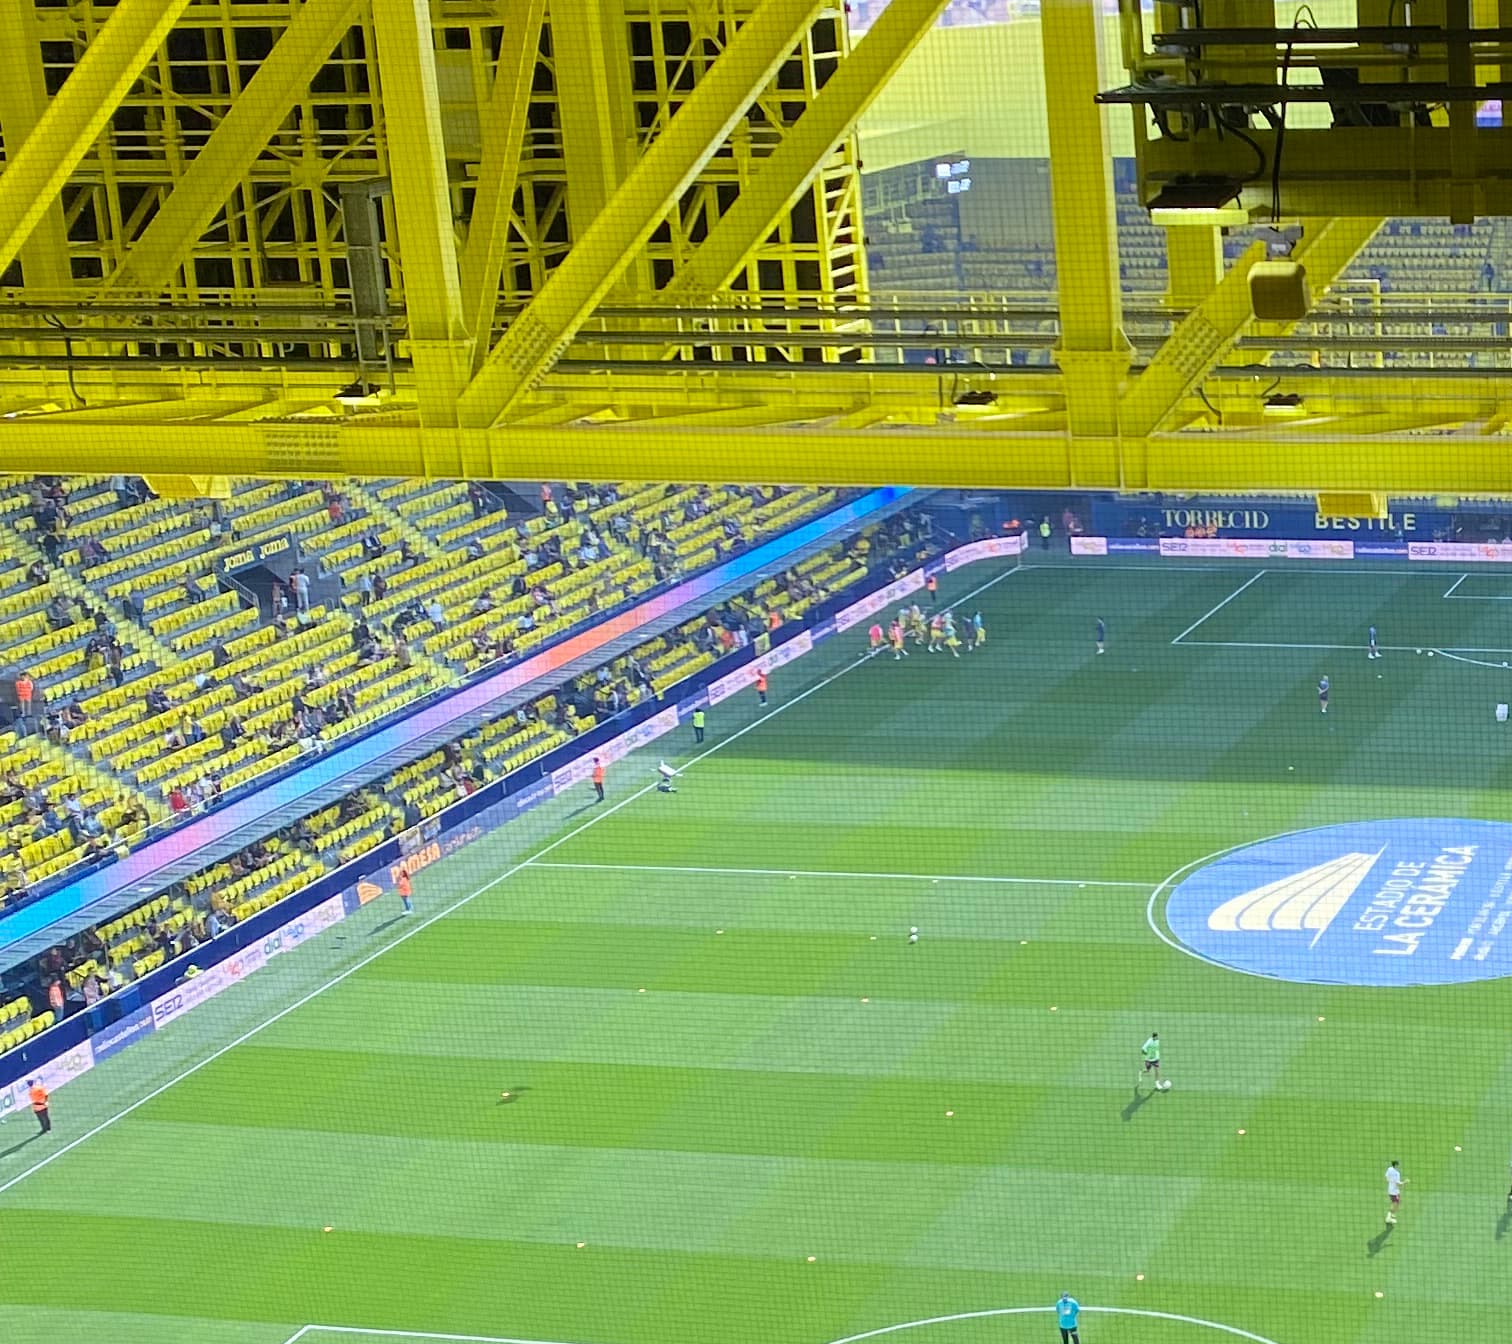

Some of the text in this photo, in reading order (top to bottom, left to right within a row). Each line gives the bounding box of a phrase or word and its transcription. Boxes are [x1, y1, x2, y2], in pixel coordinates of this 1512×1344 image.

[1161, 509, 1269, 529] TORRECID
[1352, 860, 1428, 931] ESTADIO DE
[1372, 931, 1426, 955] LA
